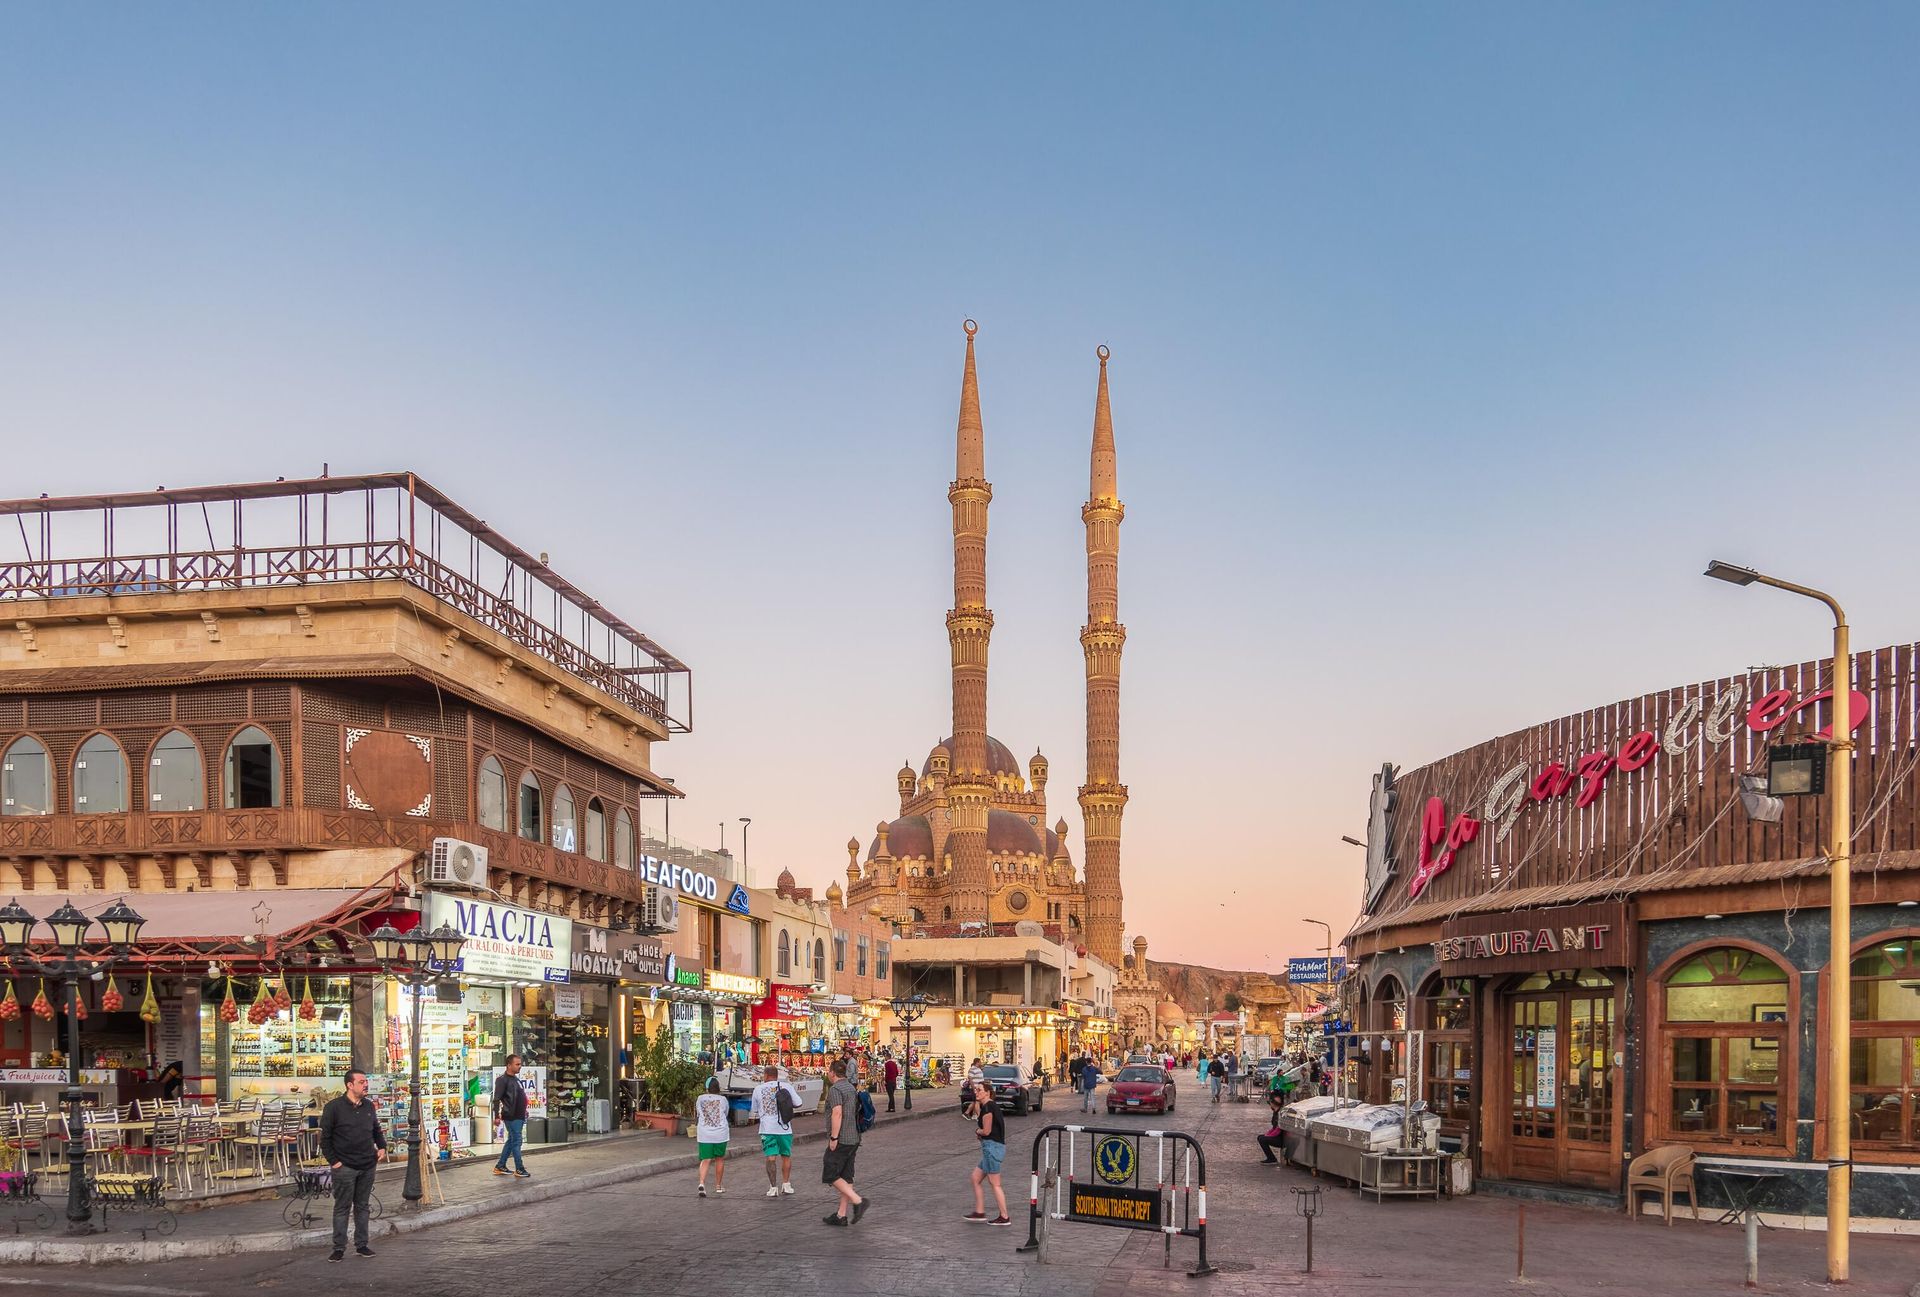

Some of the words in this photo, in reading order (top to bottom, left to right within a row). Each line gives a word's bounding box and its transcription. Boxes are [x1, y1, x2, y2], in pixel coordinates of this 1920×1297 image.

[1409, 796, 1481, 898] La
[640, 853, 717, 900] SEAFOOD
[455, 900, 553, 948] МАСЛА
[492, 942, 509, 955] OILS
[510, 945, 518, 957] &
[517, 946, 554, 961] PERFUMES
[638, 944, 663, 959] SHOES
[1433, 925, 1610, 962] RESTAURANT
[571, 952, 622, 977] MOATAZ
[623, 949, 638, 964] FOR
[638, 960, 663, 975] OUTLET
[677, 968, 700, 985] Ananas
[958, 1013, 990, 1025] YEHIA
[8, 1070, 31, 1081] Fresh
[31, 1072, 56, 1082] juices
[1075, 1195, 1095, 1216] SOUTH
[1095, 1197, 1110, 1217] SINAI
[1110, 1198, 1134, 1219] TRAFFIC
[1135, 1200, 1151, 1220] DEPT
